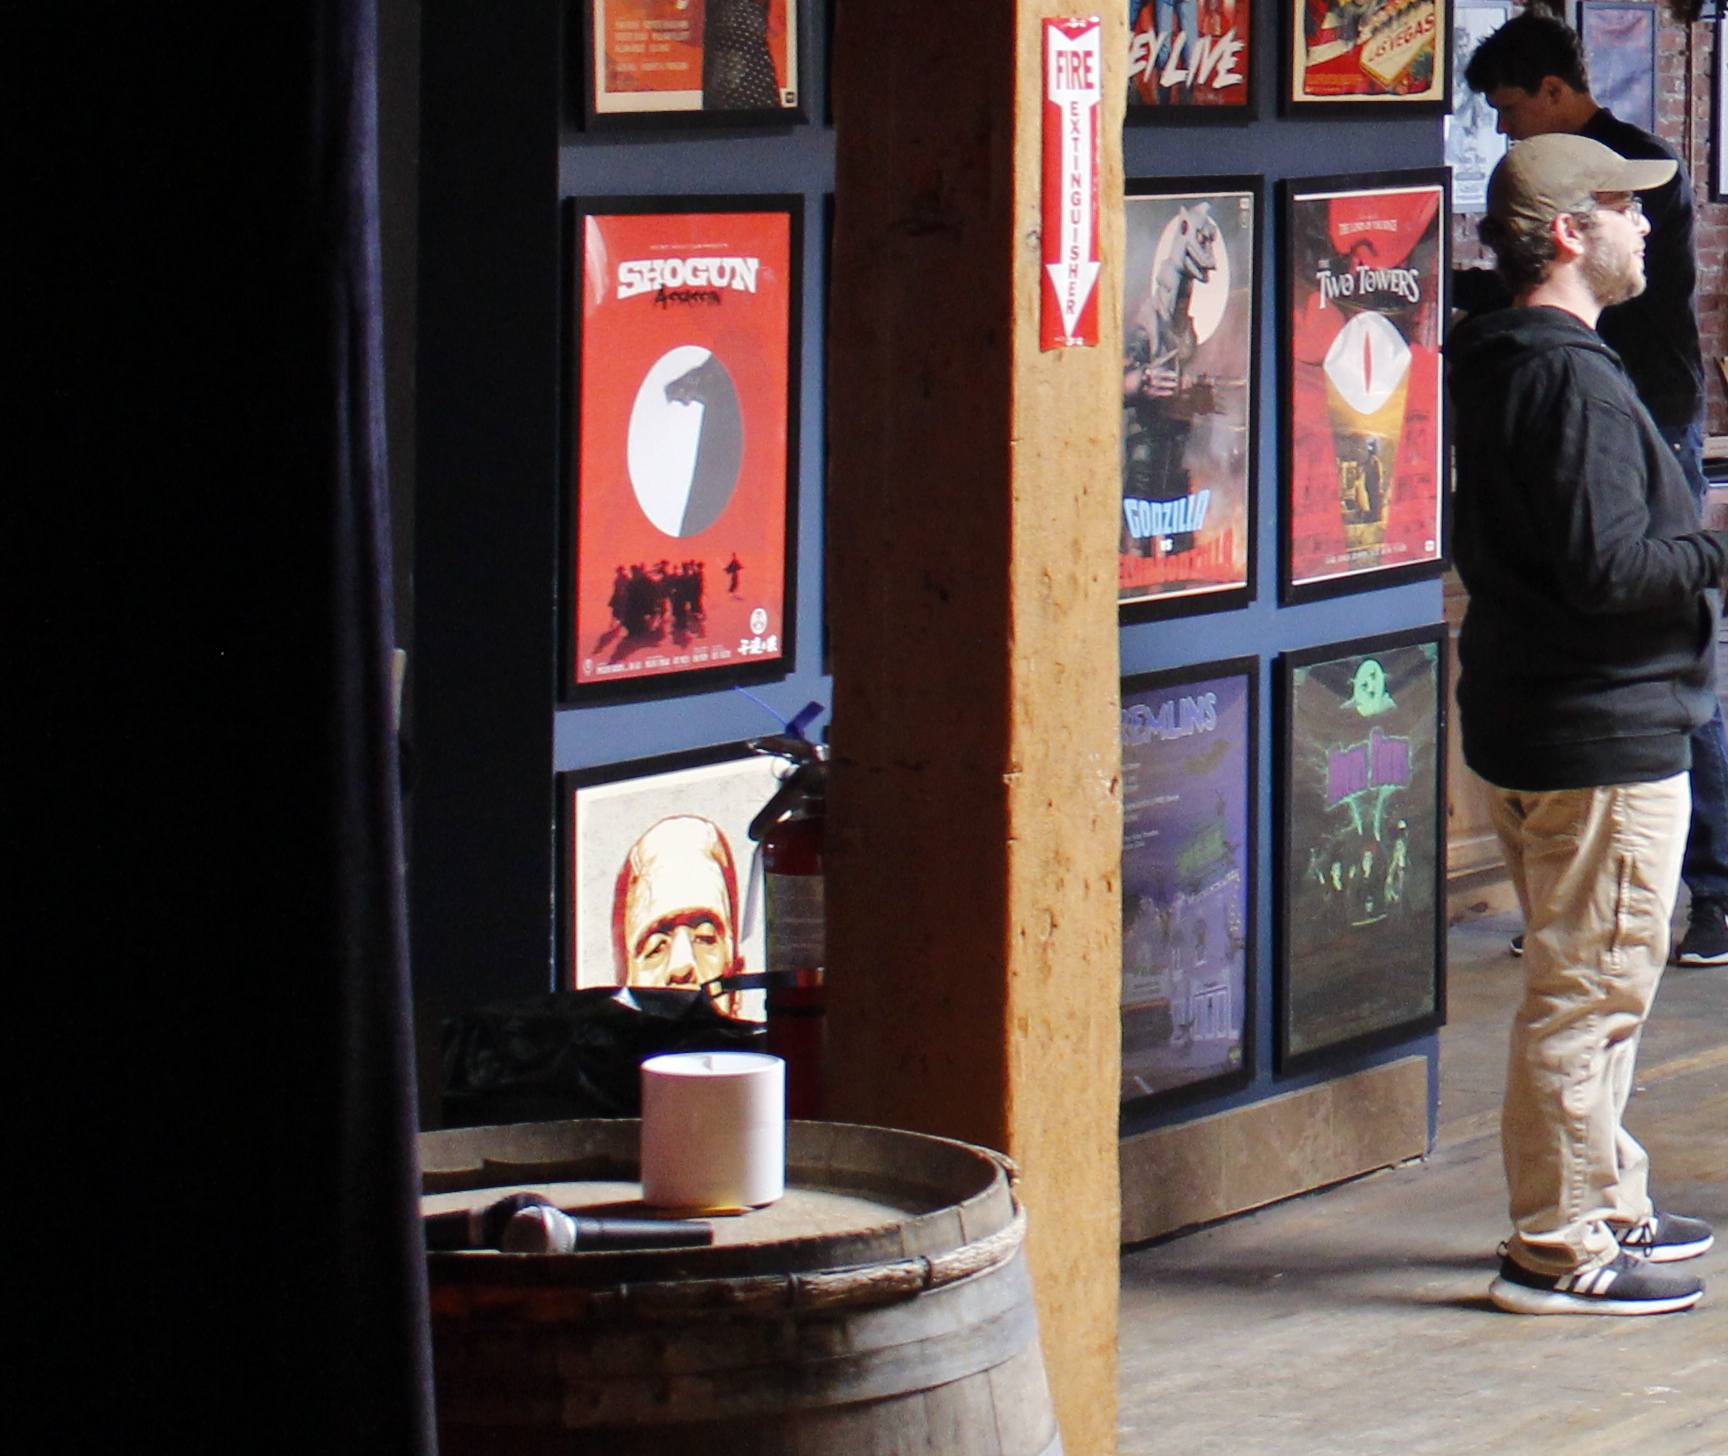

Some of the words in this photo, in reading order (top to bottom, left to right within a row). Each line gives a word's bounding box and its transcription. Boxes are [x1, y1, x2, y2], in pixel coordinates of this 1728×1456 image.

[1056, 50, 1094, 89] FIRE
[1160, 25, 1245, 89] LIVE
[1067, 101, 1081, 314] EXTINGUISHER
[617, 256, 760, 300] SHOGUN
[1124, 488, 1210, 538] GODZILLA
